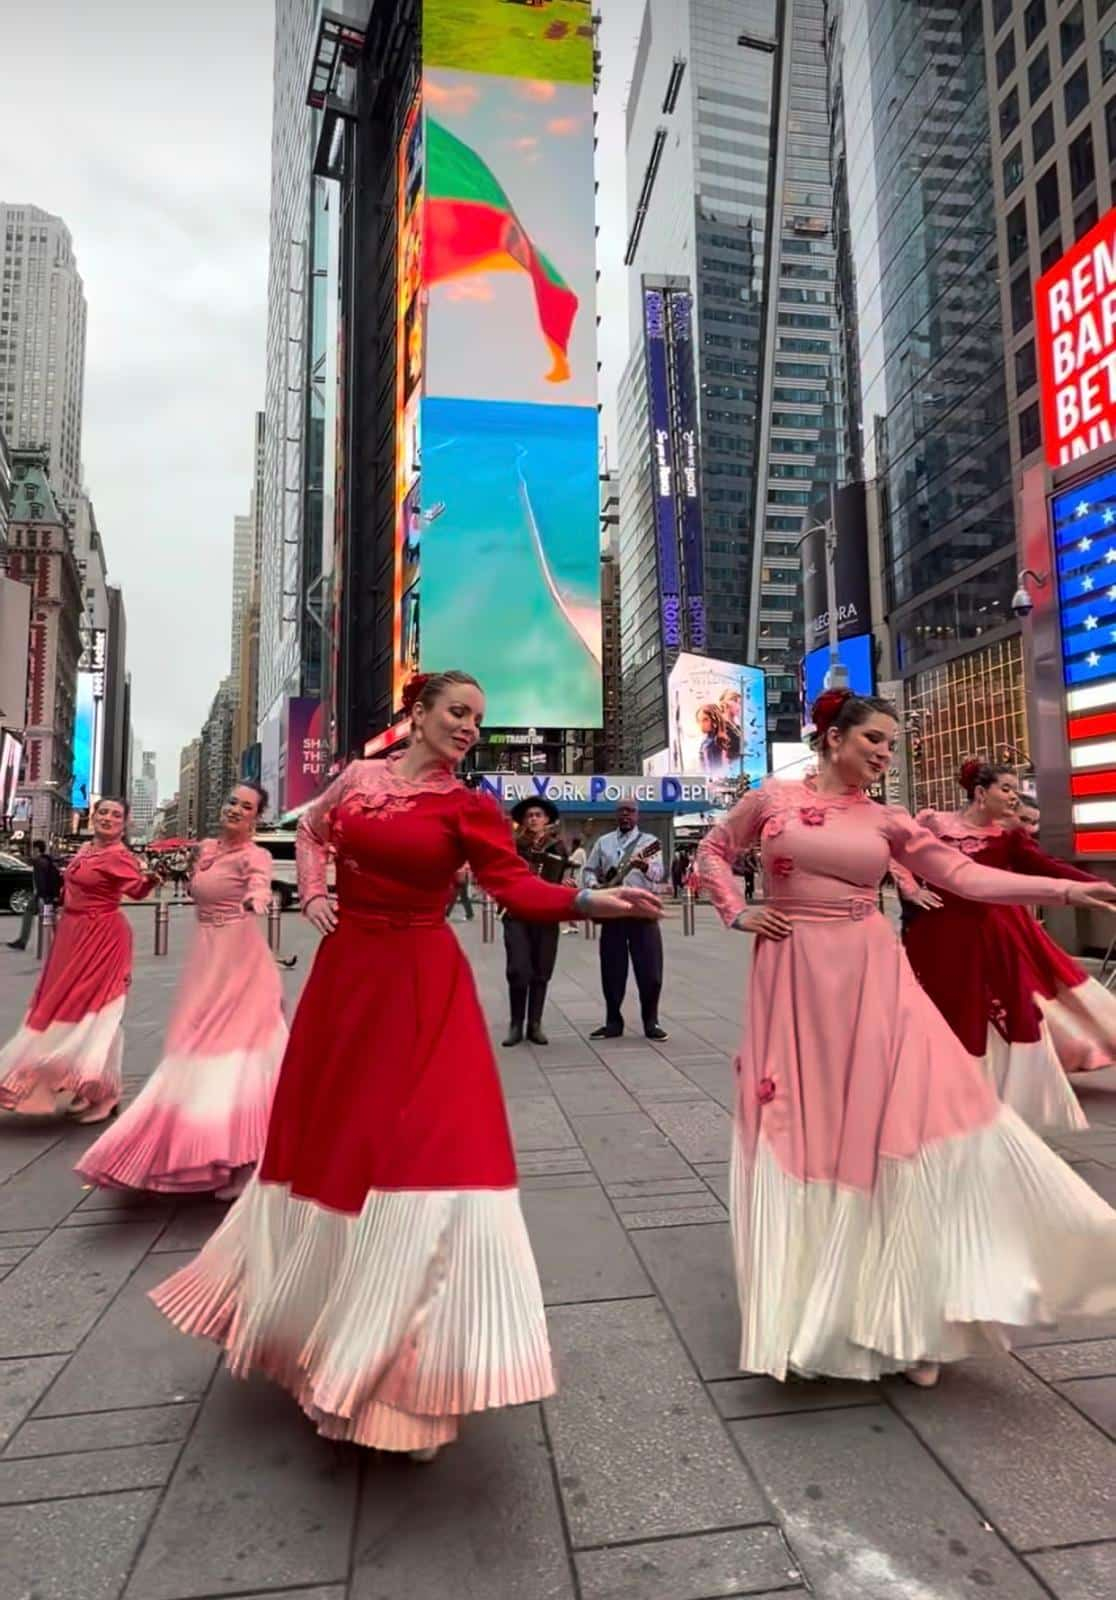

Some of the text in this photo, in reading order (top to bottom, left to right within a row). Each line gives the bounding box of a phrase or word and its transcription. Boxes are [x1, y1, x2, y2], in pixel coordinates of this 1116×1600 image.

[481, 774, 709, 801] NEW YORK POLICE DEPT
